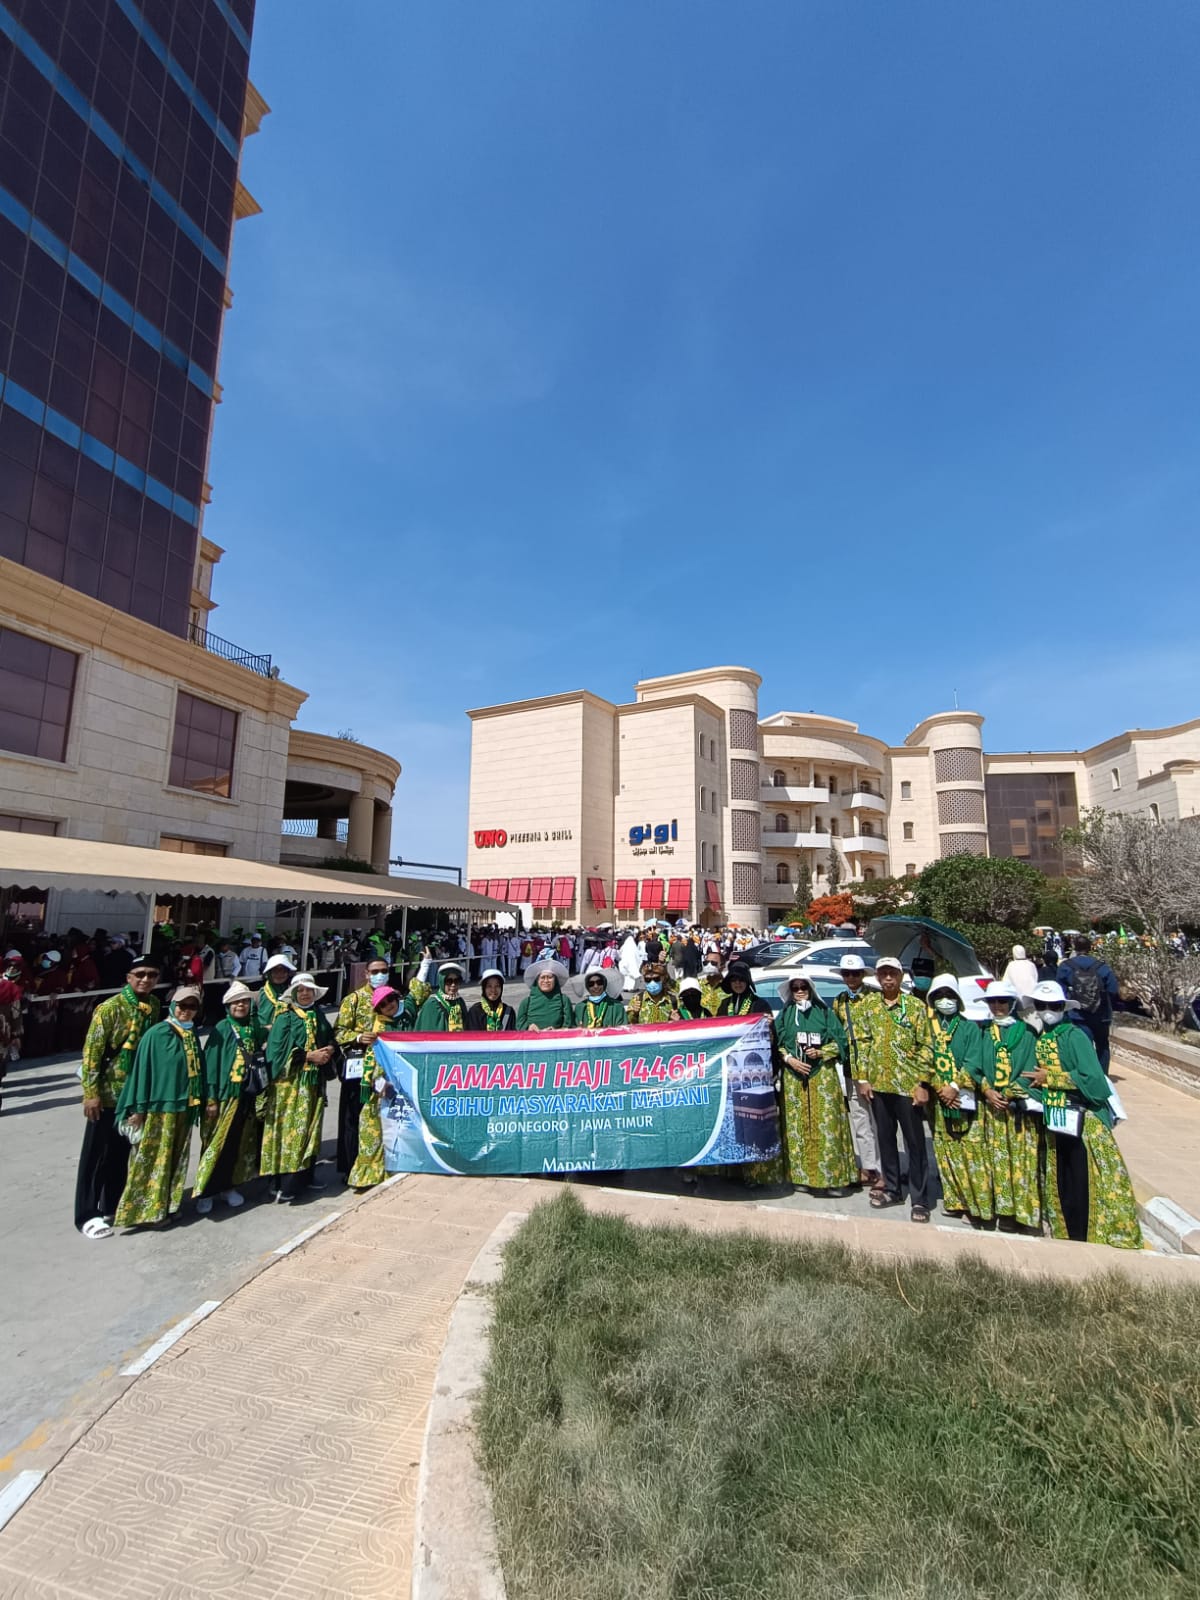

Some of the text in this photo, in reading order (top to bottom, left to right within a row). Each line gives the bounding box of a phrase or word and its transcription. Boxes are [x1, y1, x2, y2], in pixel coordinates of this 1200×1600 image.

[474, 828, 507, 849] UNO
[553, 1059, 612, 1092] HAJI
[619, 1052, 706, 1085] 1446H
[431, 1084, 710, 1117] KBIHU MASYARAKAT MADANI
[487, 1119, 569, 1134] BOJONEGORO
[580, 1117, 612, 1132] JAWA
[615, 1115, 653, 1129] TIMUR
